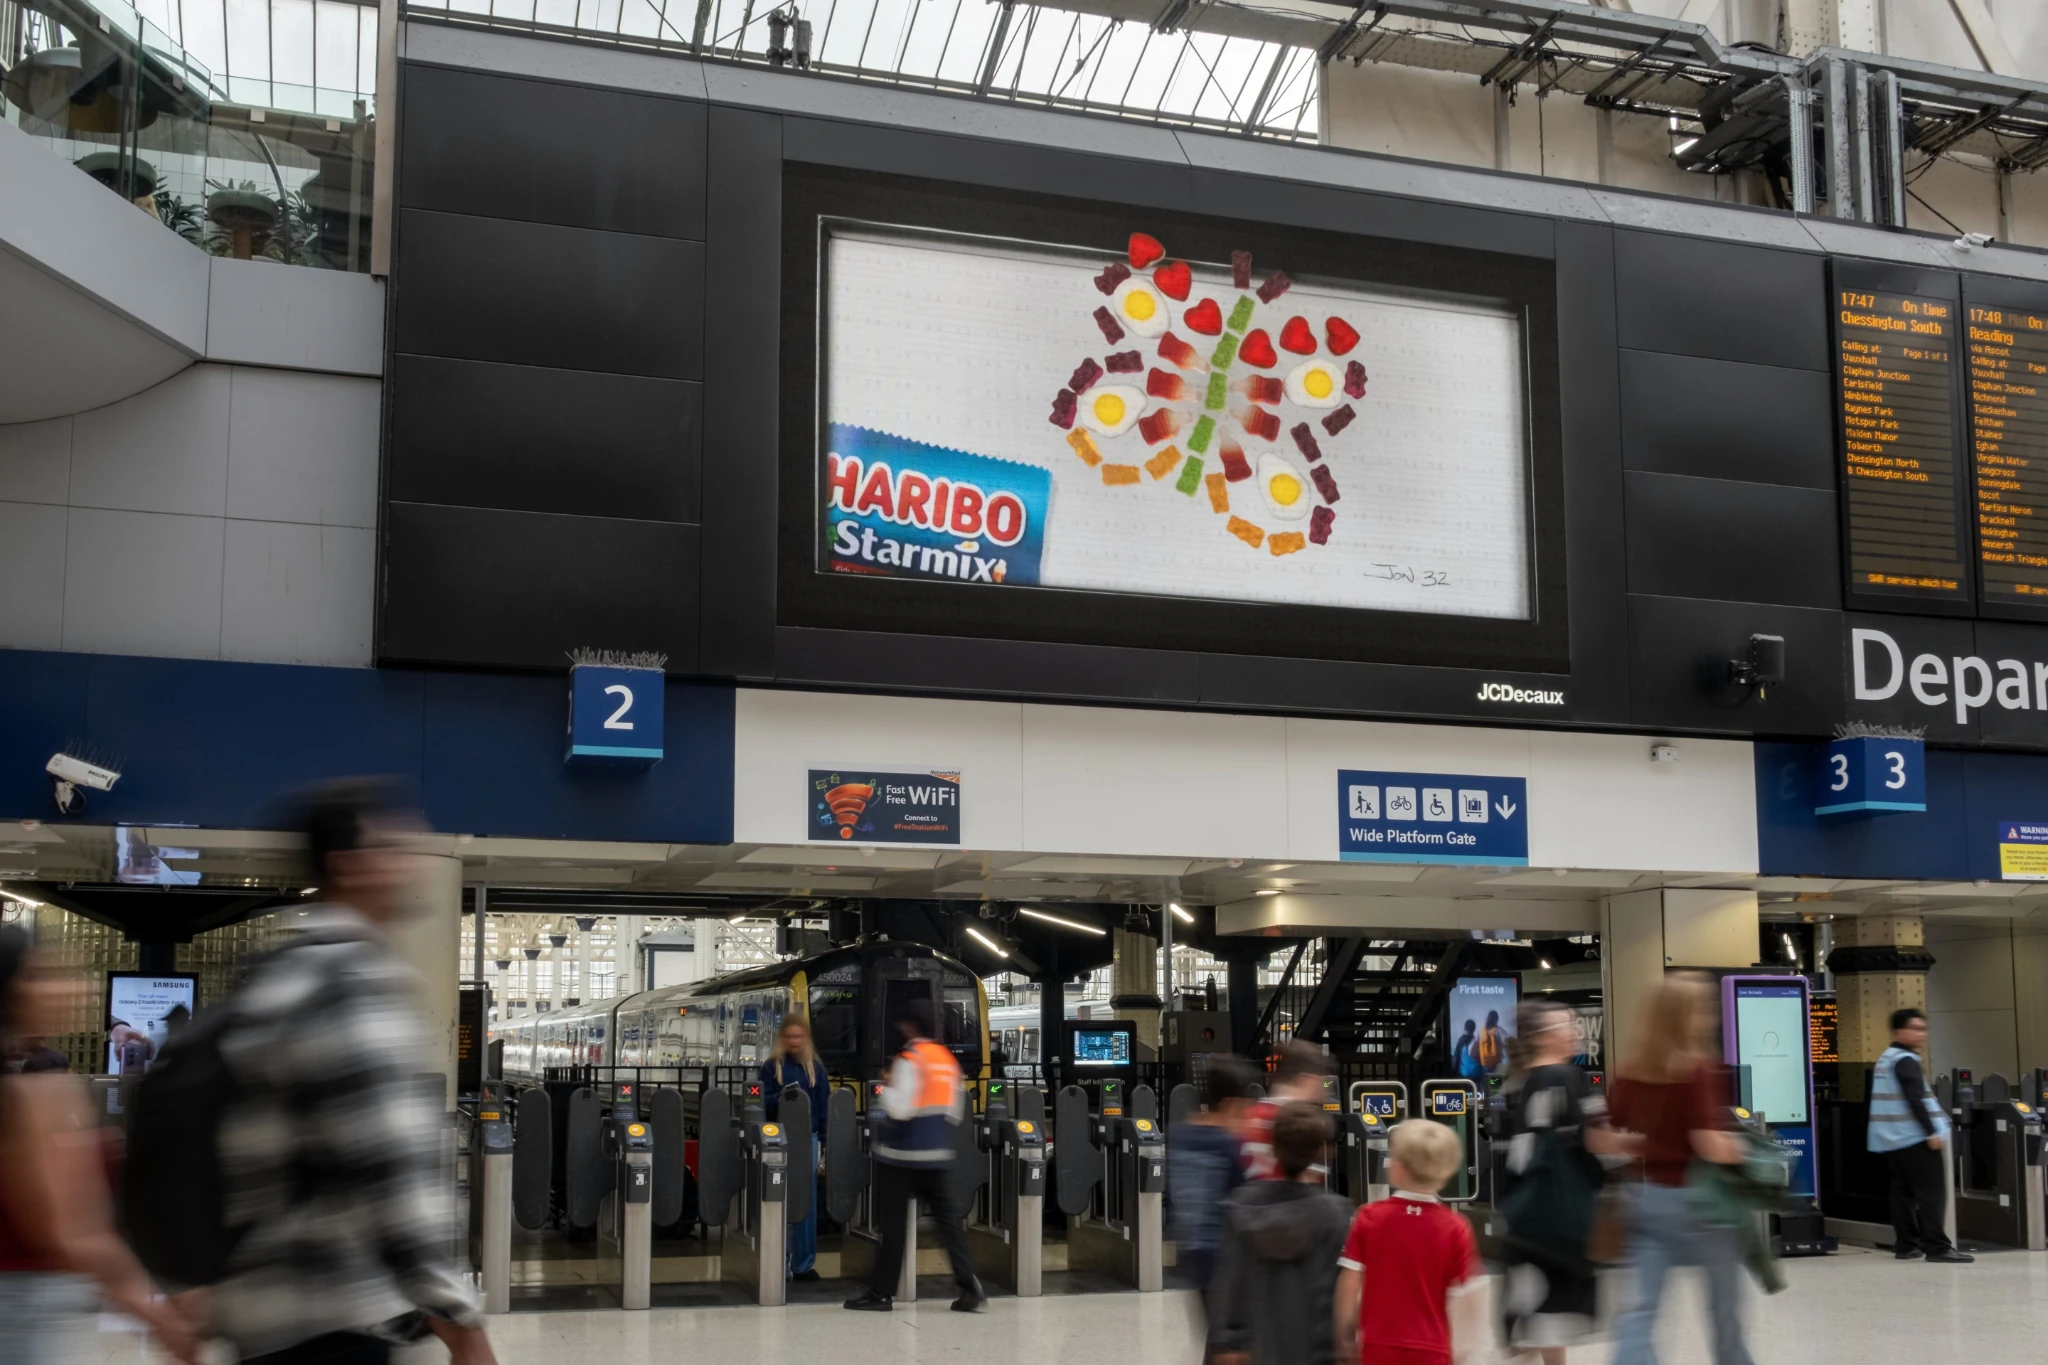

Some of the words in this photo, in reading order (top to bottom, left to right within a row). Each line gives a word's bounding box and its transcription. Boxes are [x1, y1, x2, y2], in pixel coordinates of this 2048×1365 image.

[1841, 292, 1875, 308] 17:47
[1903, 300, 1918, 314] On
[1923, 302, 1947, 317] time
[1841, 311, 1906, 331] Chessington
[1910, 320, 1942, 335] South
[1970, 308, 2002, 324] 17:48
[2028, 316, 2042, 329] On
[1970, 326, 2014, 345] Reading
[1842, 340, 1869, 354] Calling
[1871, 345, 1882, 353] at:
[1970, 344, 1982, 353] via
[1984, 345, 2010, 356] Ascot
[1842, 353, 1878, 365] Vauxhall
[1903, 348, 1922, 359] Page
[1925, 350, 1929, 359] 1
[1931, 351, 1941, 360] of
[1943, 353, 1948, 362] 1
[1971, 355, 1997, 369] Calling
[2028, 363, 2046, 374] Page
[1843, 366, 1874, 379] Clapham
[1877, 369, 1910, 381] Junction
[1972, 368, 2005, 380] Vauxhall
[1843, 378, 1883, 391] Earlsfield
[1972, 380, 2001, 392] Clapham
[2004, 383, 2036, 395] Junction
[1844, 391, 1882, 403] Wimbledon
[1973, 392, 2006, 404] Richmond
[1844, 403, 1872, 415] Raynes
[1874, 407, 1893, 417] Park
[1974, 404, 2017, 417] Twickenham
[1845, 416, 1877, 429] Motspur
[1880, 419, 1899, 430] Park
[1974, 416, 2004, 428] Feltham
[1846, 428, 1873, 439] Malden
[1874, 431, 1899, 442] Manor
[1975, 428, 2003, 440] Staines
[1846, 441, 1883, 453] Tolworth
[1976, 440, 1999, 452] Egham
[1847, 453, 1894, 467] Chessington
[1896, 458, 1919, 469] North
[1976, 453, 2005, 465] Virginia
[2006, 456, 2029, 467] Water
[1847, 466, 1854, 475] &
[1856, 467, 1903, 480] Chessington
[1905, 471, 1928, 482] South
[1977, 466, 2016, 478] Longcross
[1978, 478, 2021, 490] Sunningdale
[827, 453, 1025, 546] HARIBO
[1978, 490, 2000, 500] Ascot
[1979, 502, 2008, 513] Martins
[2010, 505, 2032, 515] Heron
[1980, 514, 2015, 526] Bracknell
[1980, 527, 2019, 539] Wokingham
[1981, 539, 2014, 550] Winnersh
[833, 520, 996, 583] Starmix
[1982, 551, 2015, 563] Winnersh
[2017, 554, 2048, 566] Triangle
[1477, 683, 1564, 705] JCDecaux
[603, 684, 634, 730] 2
[1830, 753, 1849, 792] 3
[1884, 751, 1907, 789] 3
[886, 784, 906, 794] Fast
[908, 786, 956, 806] WiFi
[886, 795, 906, 805] Free
[904, 814, 930, 822] Connect
[1350, 828, 1384, 842] Wide
[1387, 829, 1443, 844] Platform
[1446, 831, 1477, 845] Gate
[817, 973, 852, 982] 450024
[944, 973, 969, 983] 50024
[819, 991, 853, 999] oking
[1459, 984, 1480, 995] First
[1481, 985, 1504, 995] taste
